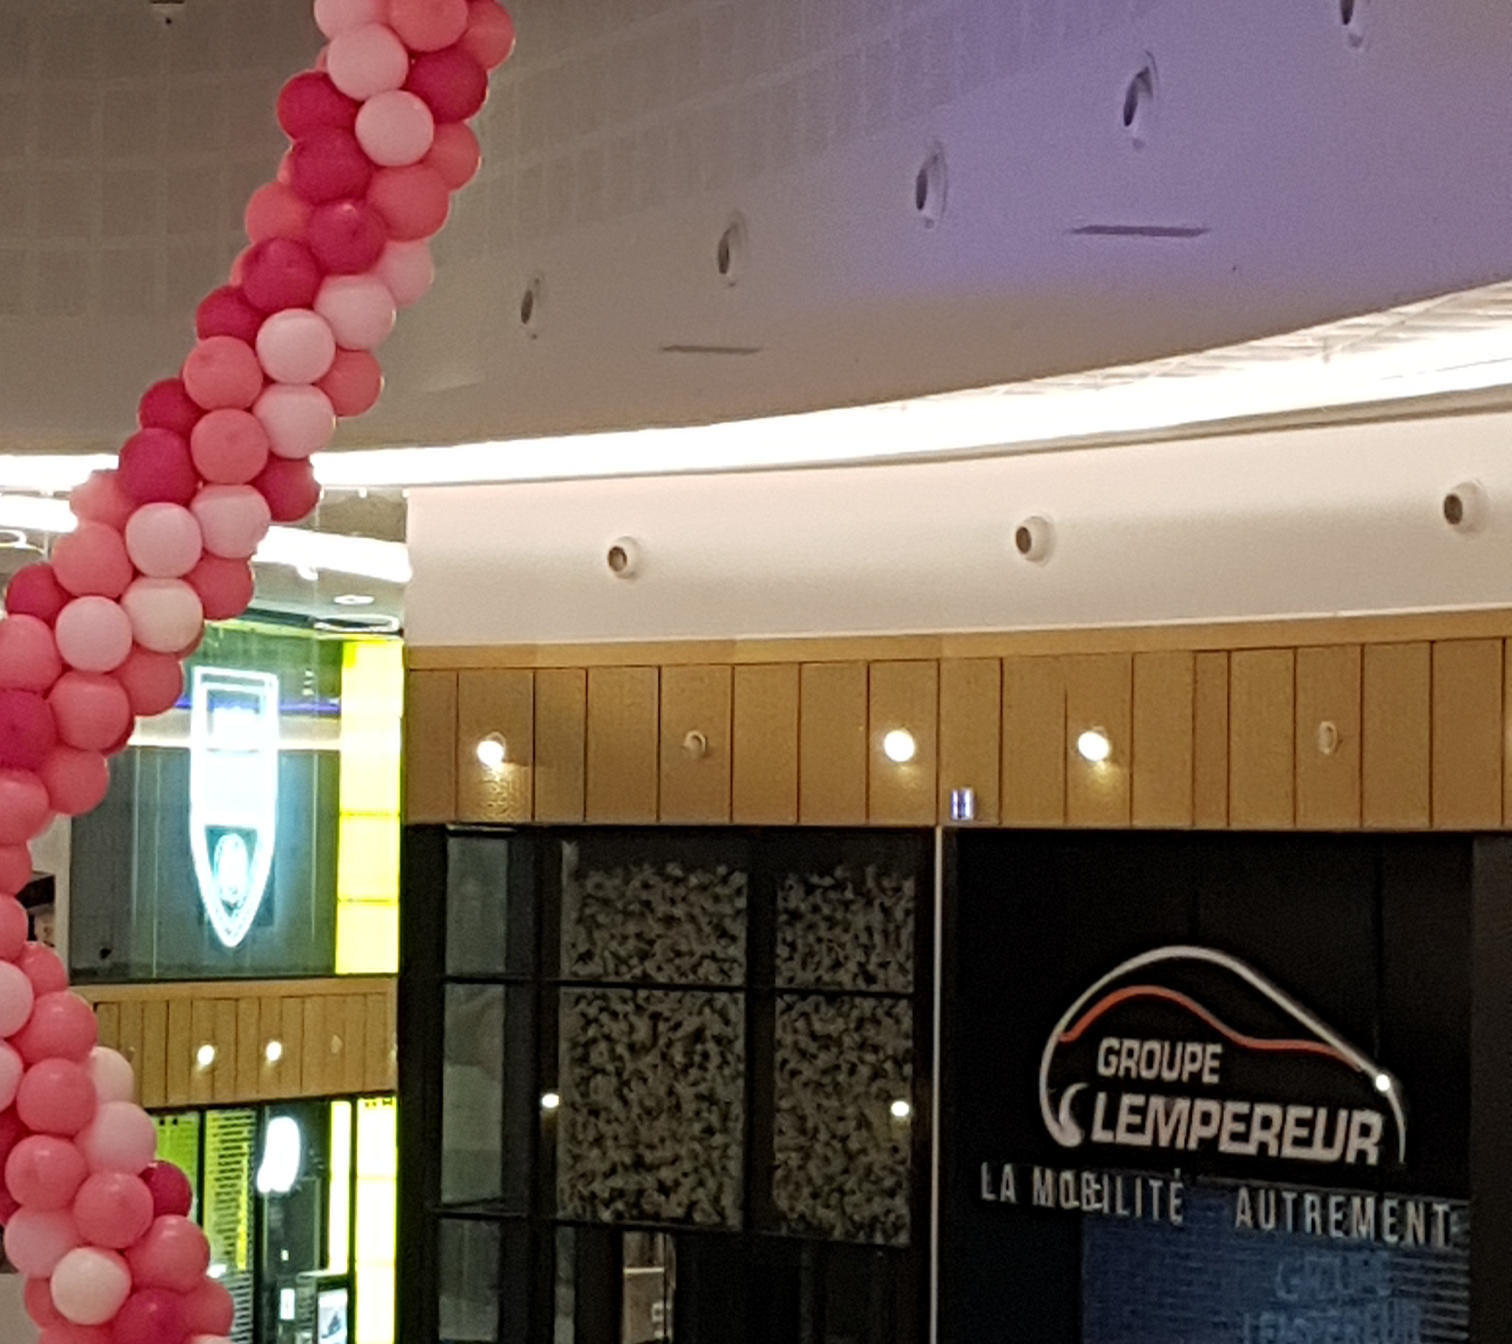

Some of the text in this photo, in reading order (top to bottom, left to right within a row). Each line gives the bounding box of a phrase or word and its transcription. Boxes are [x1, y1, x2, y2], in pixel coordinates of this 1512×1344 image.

[1096, 1037, 1224, 1085] GROUPE
[1091, 1091, 1386, 1167] LEMPEREUR
[980, 1161, 1018, 1204] LA
[1234, 1185, 1452, 1248] AUTREMENT
